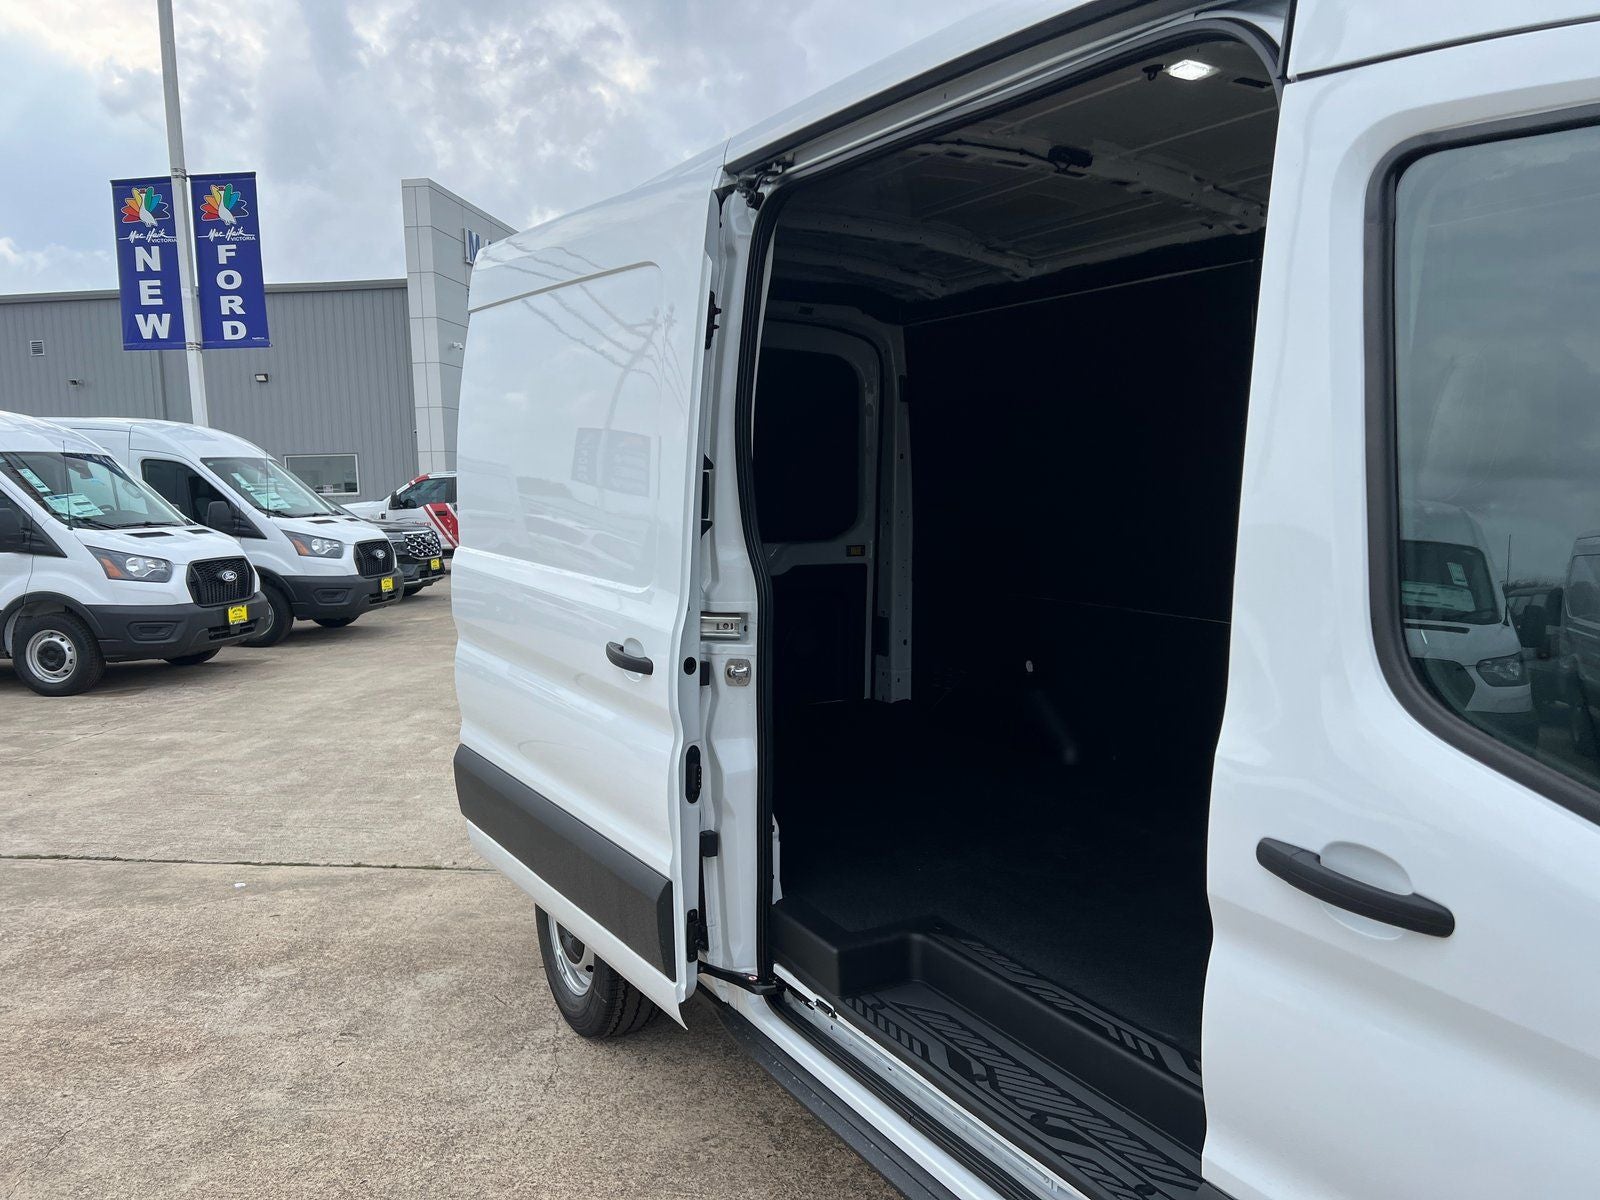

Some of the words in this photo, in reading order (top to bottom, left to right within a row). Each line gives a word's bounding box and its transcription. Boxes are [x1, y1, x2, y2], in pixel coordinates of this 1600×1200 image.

[146, 228, 167, 243] Haik
[225, 226, 246, 241] Haik
[135, 246, 171, 340] NEW
[216, 244, 247, 341] FORD
